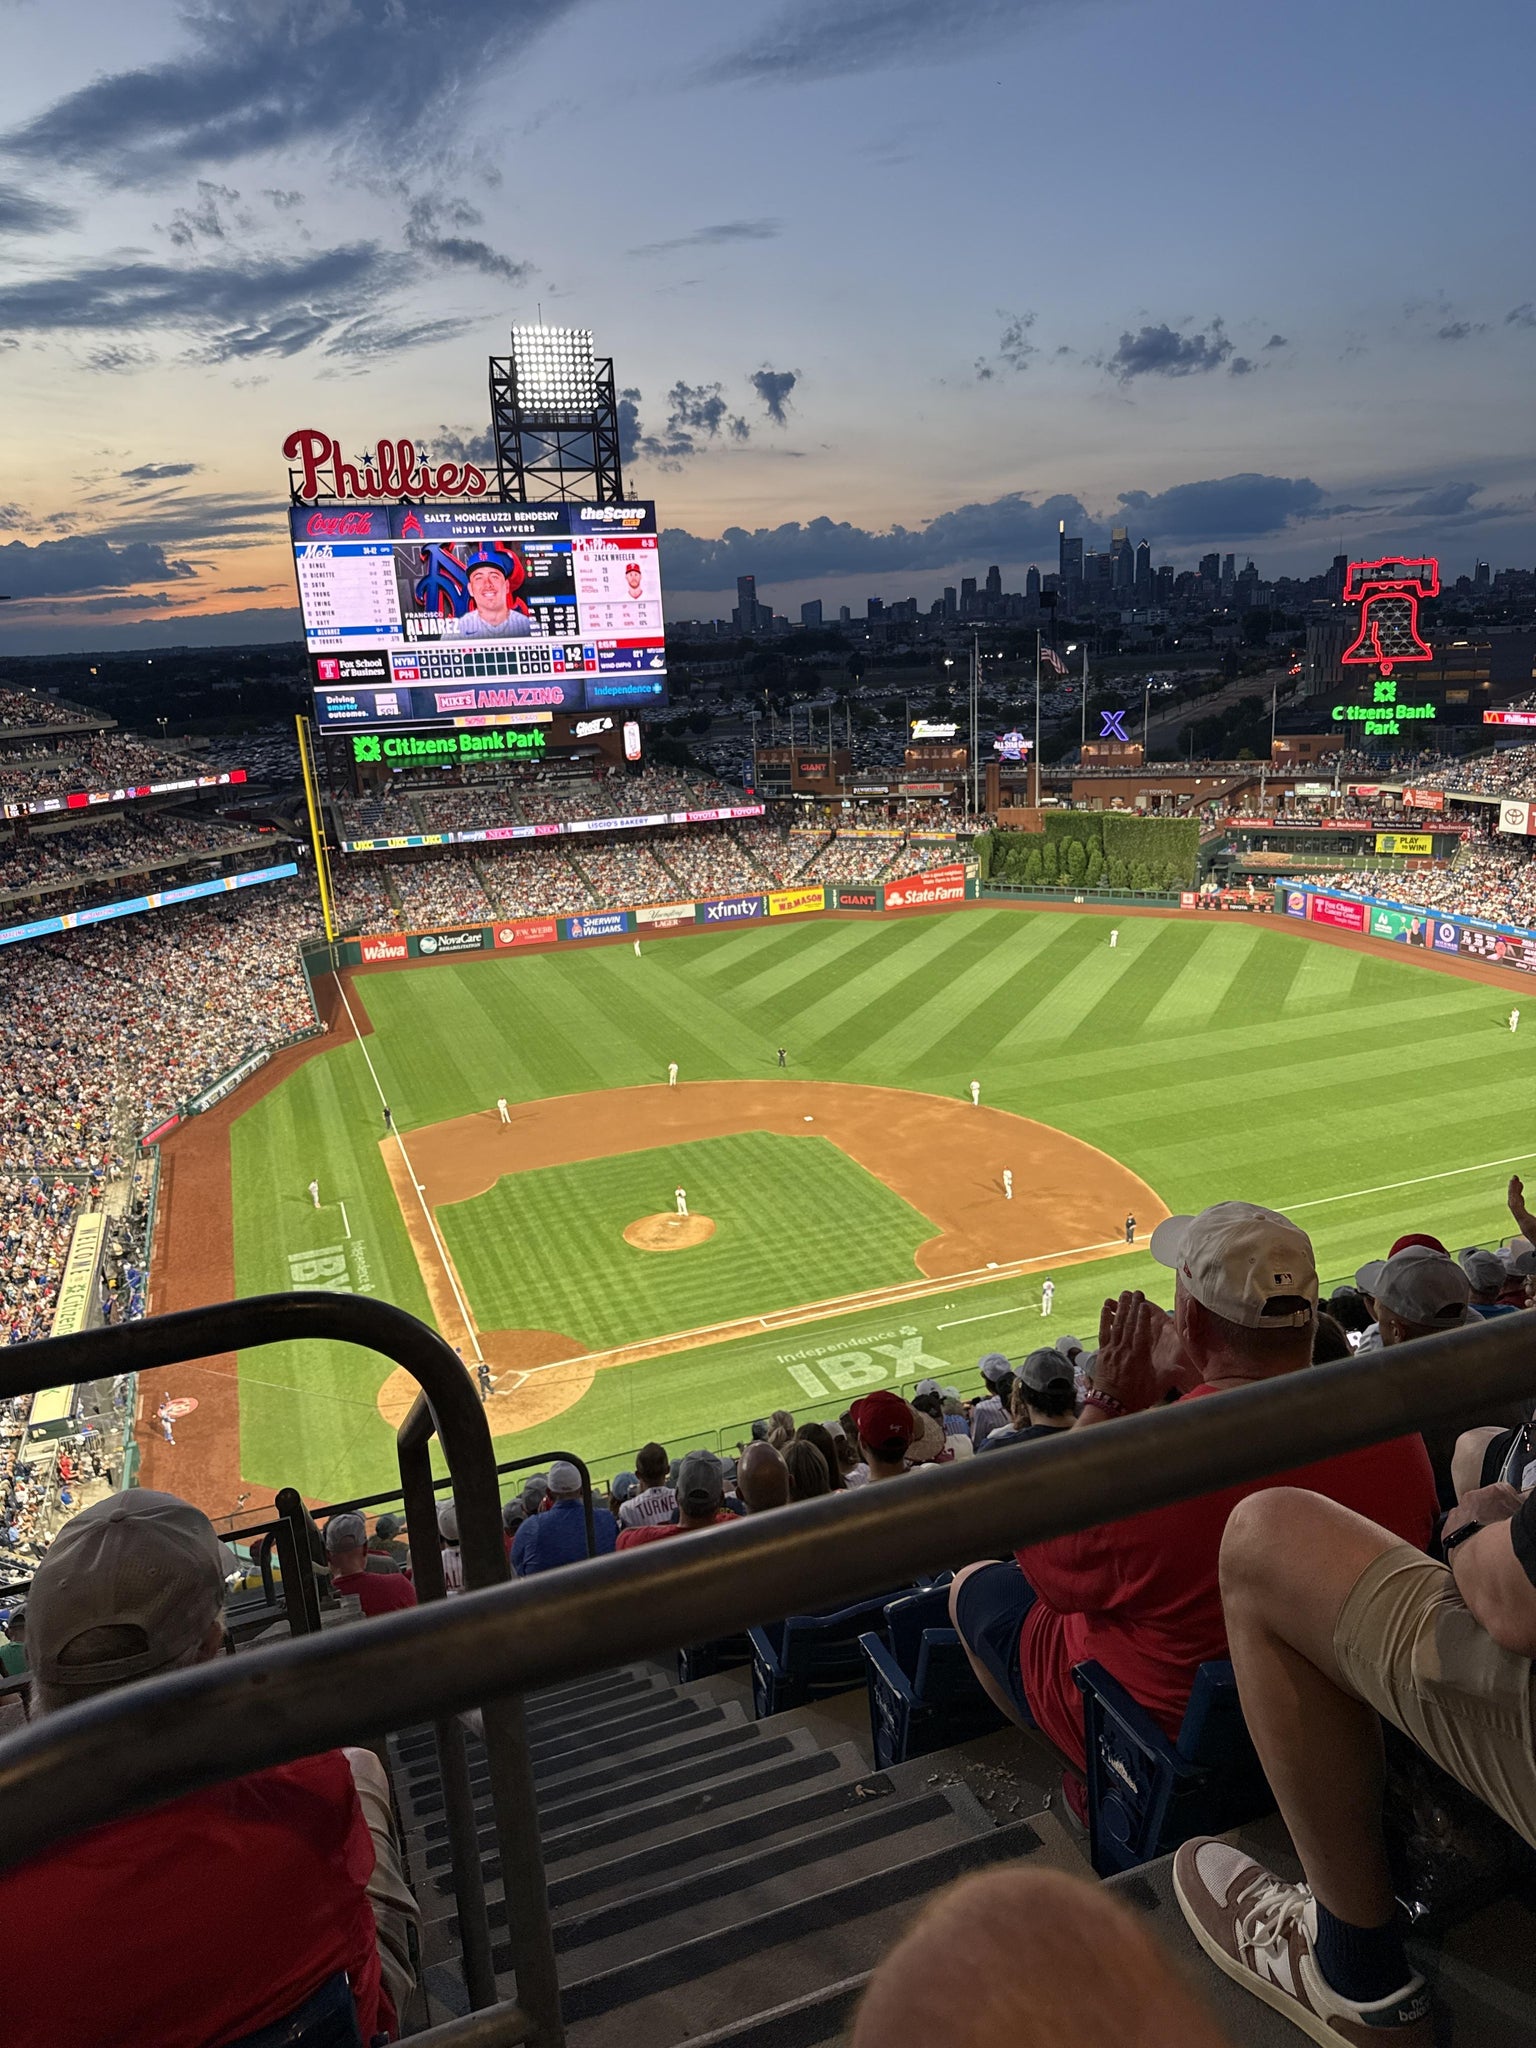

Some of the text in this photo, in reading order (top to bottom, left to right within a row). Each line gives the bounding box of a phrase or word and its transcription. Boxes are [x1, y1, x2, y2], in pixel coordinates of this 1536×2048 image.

[283, 429, 487, 500] Phillies
[424, 511, 559, 523] SALTZ MONGELUZZI BENDESKY
[580, 506, 646, 520] theScore
[452, 525, 535, 534] INJURY LAWYERS
[300, 545, 333, 559] Mets
[406, 617, 460, 635] ALVAREZ
[566, 647, 582, 661] 1-2
[339, 658, 383, 669] Fox School
[394, 657, 416, 666] NYM
[340, 668, 385, 677] of Business
[398, 670, 414, 678] PHI
[594, 684, 651, 697] Independence
[326, 695, 355, 704] Driving
[441, 695, 472, 707] MIKE'S
[477, 686, 564, 709] AMAZING
[1396, 703, 1436, 719] Bank
[1100, 711, 1129, 741] X
[1504, 715, 1528, 724] Phillies
[1365, 721, 1399, 735] Park
[383, 737, 457, 757] Citizens
[459, 730, 505, 752] Bank
[506, 728, 545, 749] Park
[800, 763, 827, 771] GIANT
[688, 811, 718, 820] TOYOTA
[732, 807, 761, 816] TOYOTA
[587, 817, 648, 830] LISCIO'S BAKERY
[1400, 836, 1419, 844] PLAY
[1409, 844, 1427, 852] WIN!
[840, 895, 876, 905] GIANT
[1324, 900, 1354, 912] Fox Chase
[707, 901, 758, 920] xfinity
[1324, 907, 1361, 920] Cancer Center
[583, 916, 621, 927] SHERWIN
[655, 919, 678, 928] LAGER
[531, 926, 553, 934] WEBB
[437, 933, 482, 946] NovaCare
[363, 945, 405, 960] Wawa
[69, 1226, 100, 1275] WELCOME
[776, 1330, 897, 1364] Independence
[786, 1336, 951, 1399] IBX
[635, 1494, 675, 1520] TURNE
